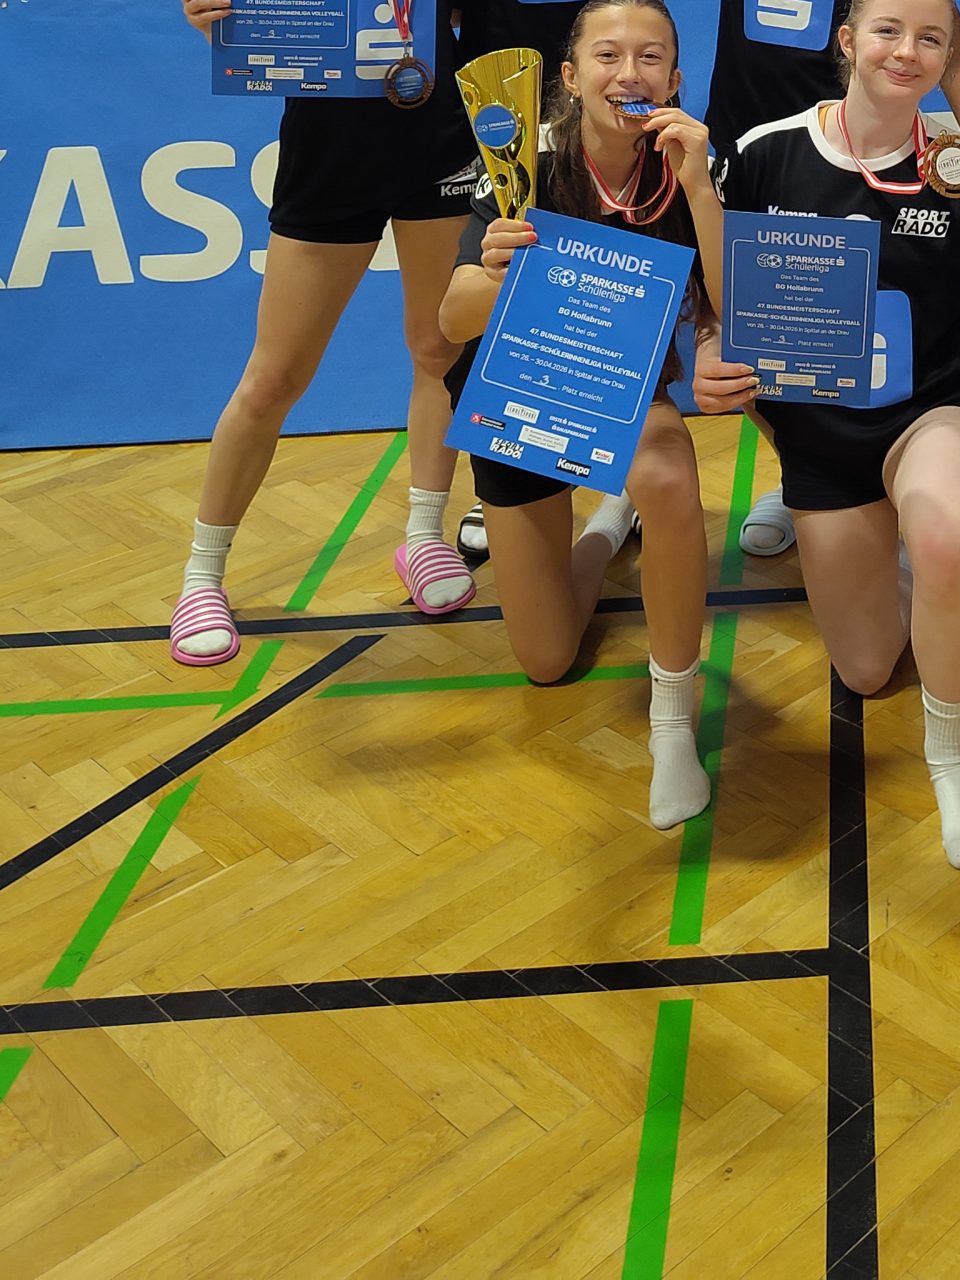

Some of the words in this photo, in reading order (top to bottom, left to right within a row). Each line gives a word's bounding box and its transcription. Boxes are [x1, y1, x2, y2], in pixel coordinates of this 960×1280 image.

[440, 184, 478, 198] Kemp
[899, 207, 950, 223] SPORT
[895, 220, 949, 237] RADO
[758, 230, 844, 248] URKUNDE
[555, 237, 653, 277] URKUNDE
[786, 255, 835, 265] SPARKASSE
[785, 262, 829, 273] Schülerliga
[579, 272, 635, 295] SPARKASSE
[575, 282, 626, 304] Schülerliga
[567, 296, 581, 305] Das
[581, 300, 599, 310] Team
[598, 305, 611, 313] des
[557, 306, 570, 316] BG
[570, 310, 613, 328] Hollabrunn
[563, 323, 575, 332] hat
[575, 326, 586, 335] bei
[585, 329, 598, 338] der
[528, 327, 540, 336] 47.
[539, 330, 623, 360] BUNDESMEISTERSCHAFT
[573, 369, 593, 381] Spittal
[600, 377, 611, 386] der
[610, 380, 626, 390] Drau
[601, 362, 643, 380] VOLLEYBALL
[518, 372, 532, 381] den
[538, 373, 550, 386] 3
[561, 384, 579, 395] Platz
[577, 389, 603, 403] erreicht
[555, 457, 590, 478] Kempa
